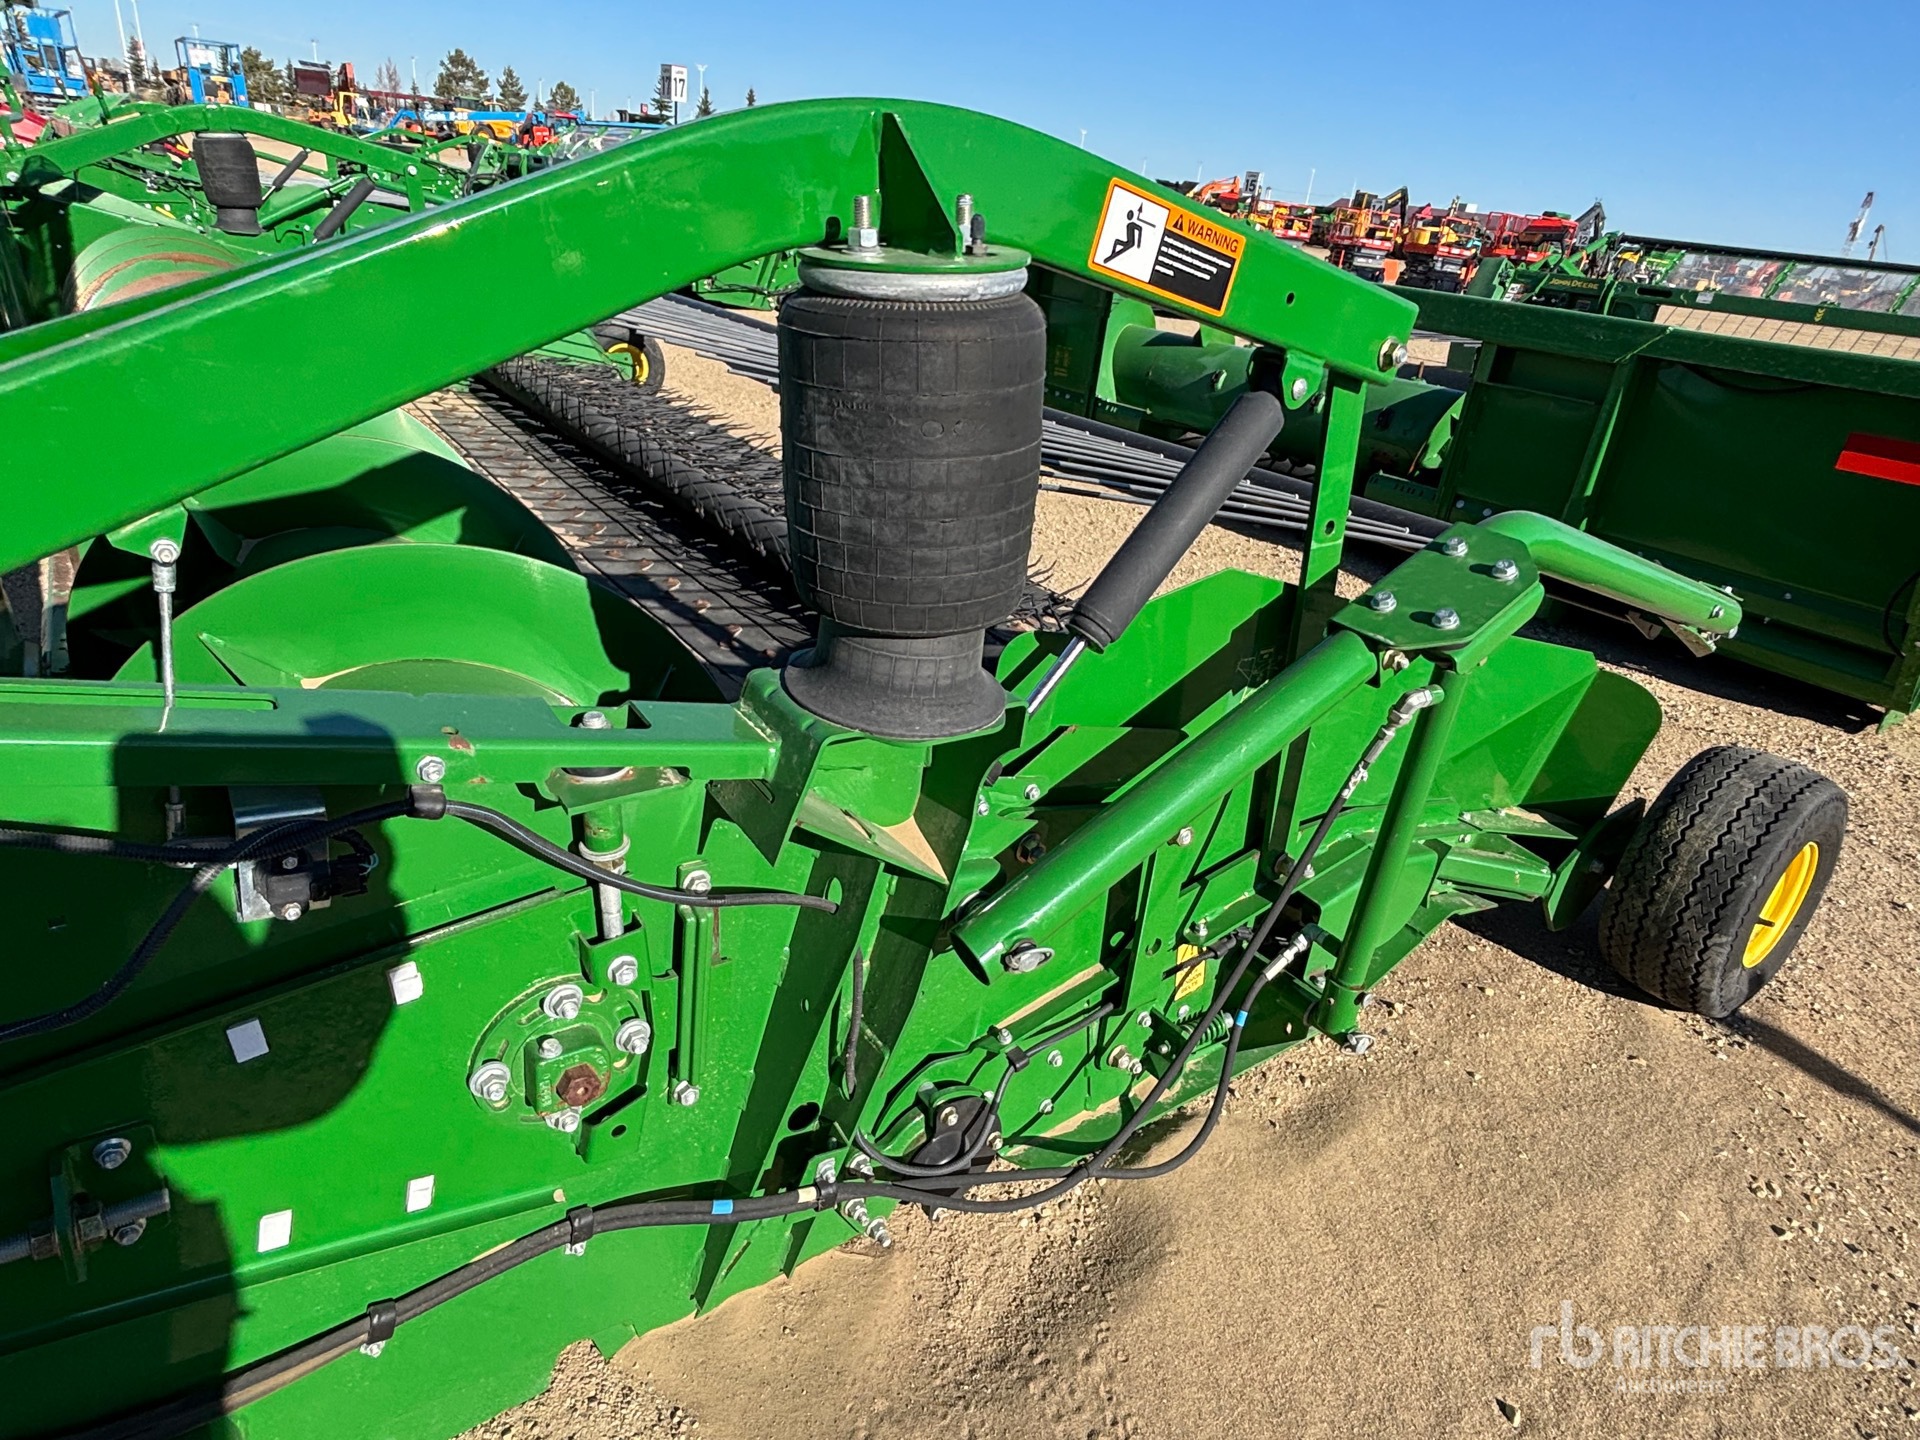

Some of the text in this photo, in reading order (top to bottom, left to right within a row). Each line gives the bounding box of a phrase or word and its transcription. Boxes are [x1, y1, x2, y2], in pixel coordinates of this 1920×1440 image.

[673, 77, 685, 98] 17
[1245, 179, 1257, 192] 15
[1188, 219, 1239, 253] WARNING
[1578, 235, 1588, 245] 12
[1549, 278, 1599, 290] JOHN DEERE
